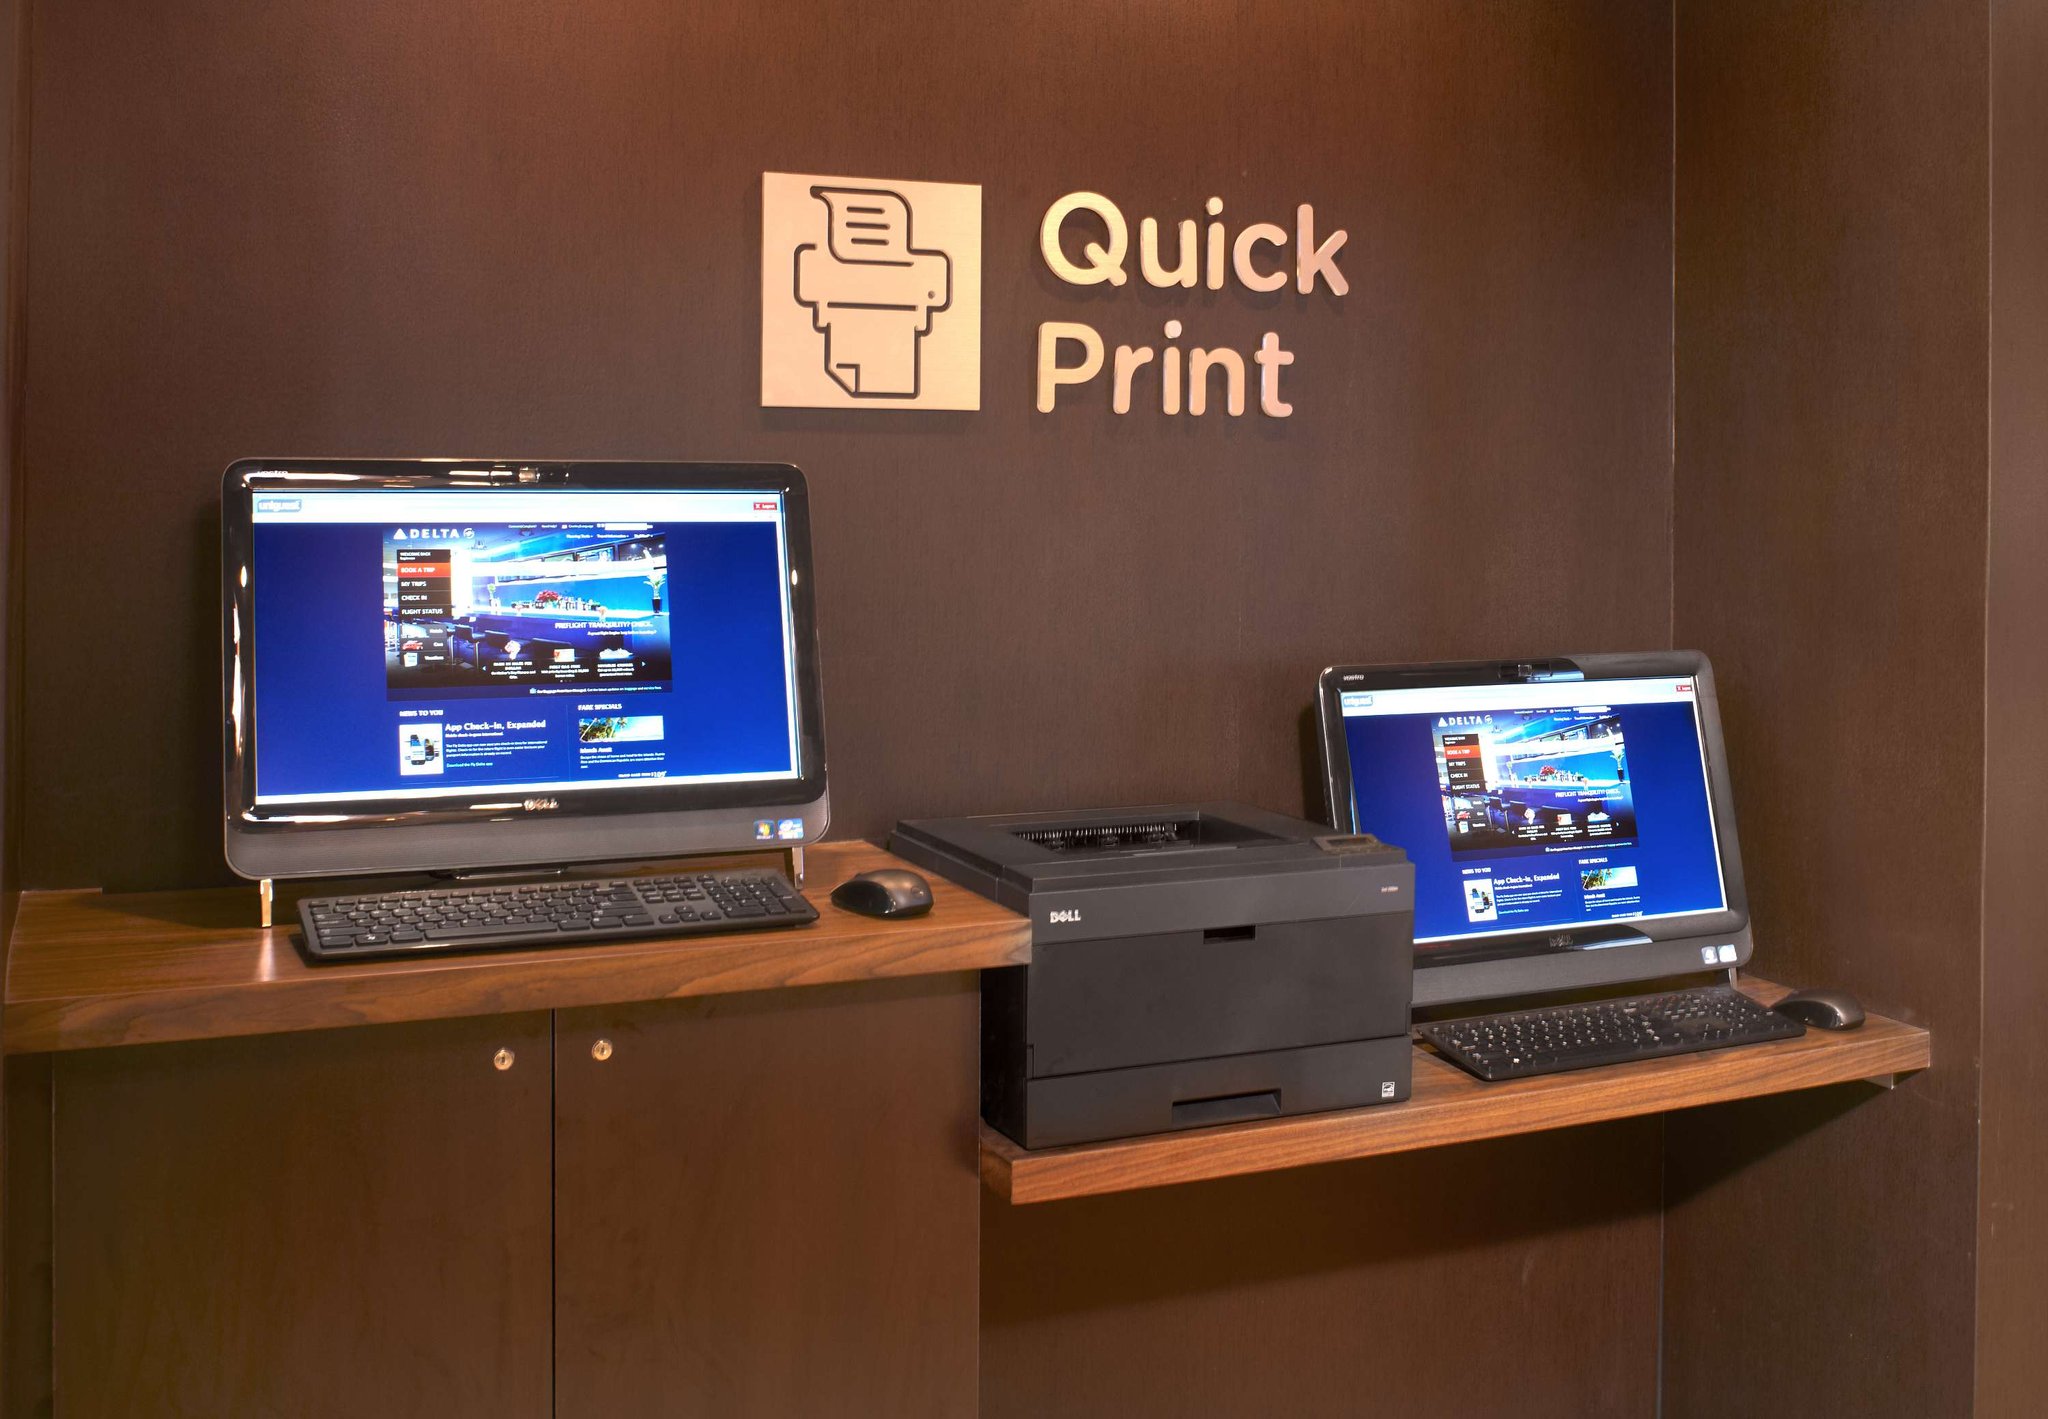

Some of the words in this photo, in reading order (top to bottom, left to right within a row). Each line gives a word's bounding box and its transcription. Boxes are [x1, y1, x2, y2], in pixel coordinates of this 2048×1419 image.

[1040, 191, 1349, 296] Quick
[1037, 320, 1295, 418] Print
[409, 528, 460, 539] DELTA
[445, 723, 463, 732] App
[506, 719, 546, 730] Expanded
[1448, 715, 1483, 726] DELTA
[1533, 873, 1560, 882] Expanded
[1050, 909, 1081, 923] DELL
